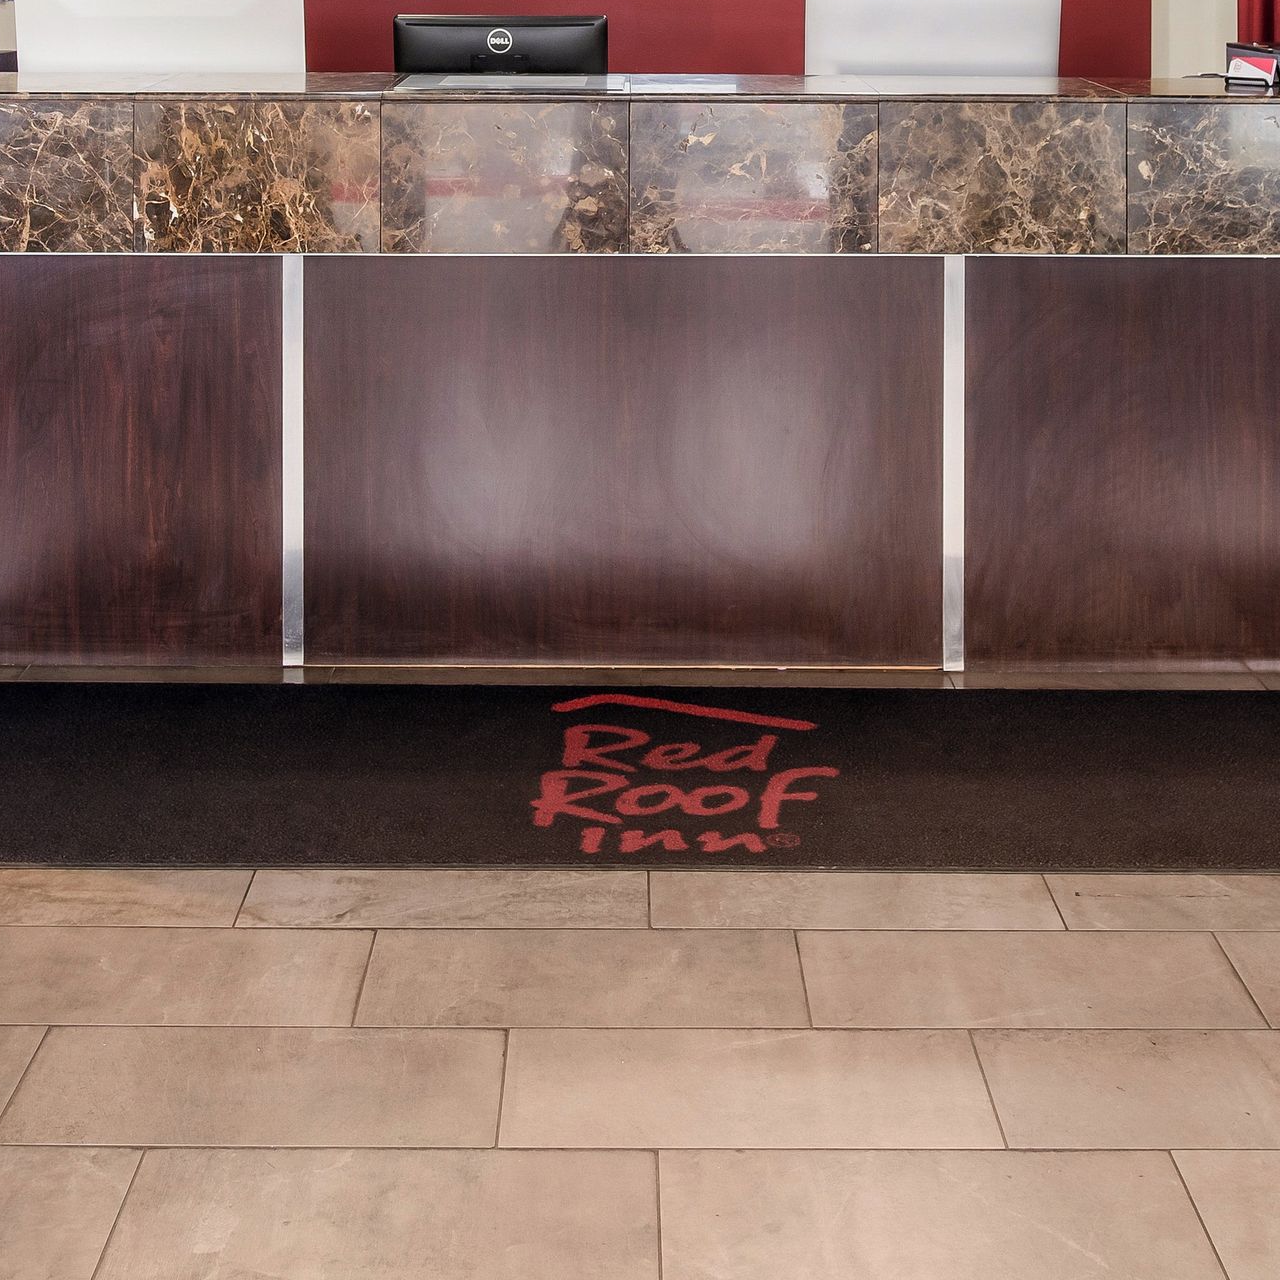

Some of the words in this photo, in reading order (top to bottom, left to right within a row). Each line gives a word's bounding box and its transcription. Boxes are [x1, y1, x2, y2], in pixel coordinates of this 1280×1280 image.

[490, 37, 510, 45] DELL
[562, 723, 777, 771] Red
[530, 766, 840, 829] Roof
